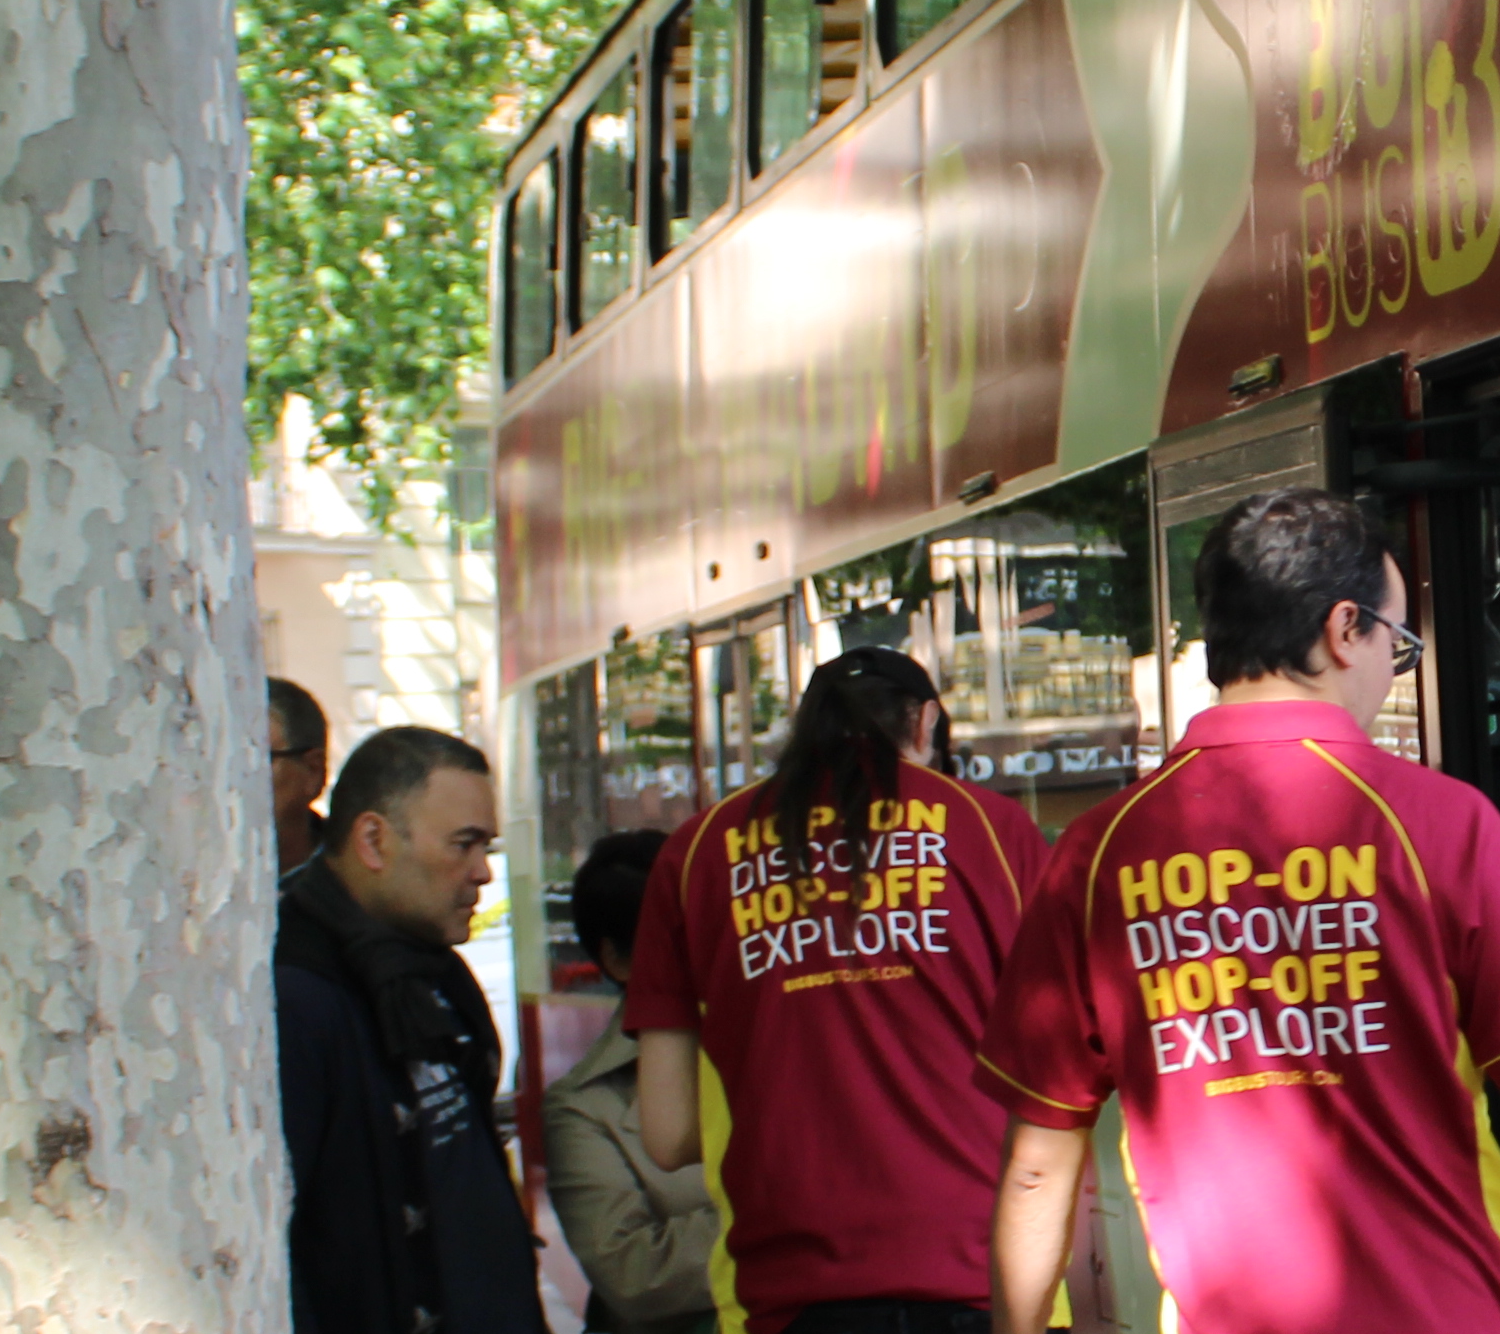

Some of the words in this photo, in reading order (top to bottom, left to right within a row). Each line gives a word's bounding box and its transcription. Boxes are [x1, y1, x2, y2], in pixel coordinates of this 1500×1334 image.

[1302, 145, 1412, 344] BUS
[725, 798, 947, 864] HOPON
[731, 867, 947, 937] HOP-OFF
[1118, 844, 1377, 919] HOP-ON
[739, 909, 950, 980] EXPLORE
[1127, 900, 1381, 970] DISCOVER
[1138, 950, 1381, 1020] HOP-OFF
[1150, 1001, 1391, 1075] EXPLORE
